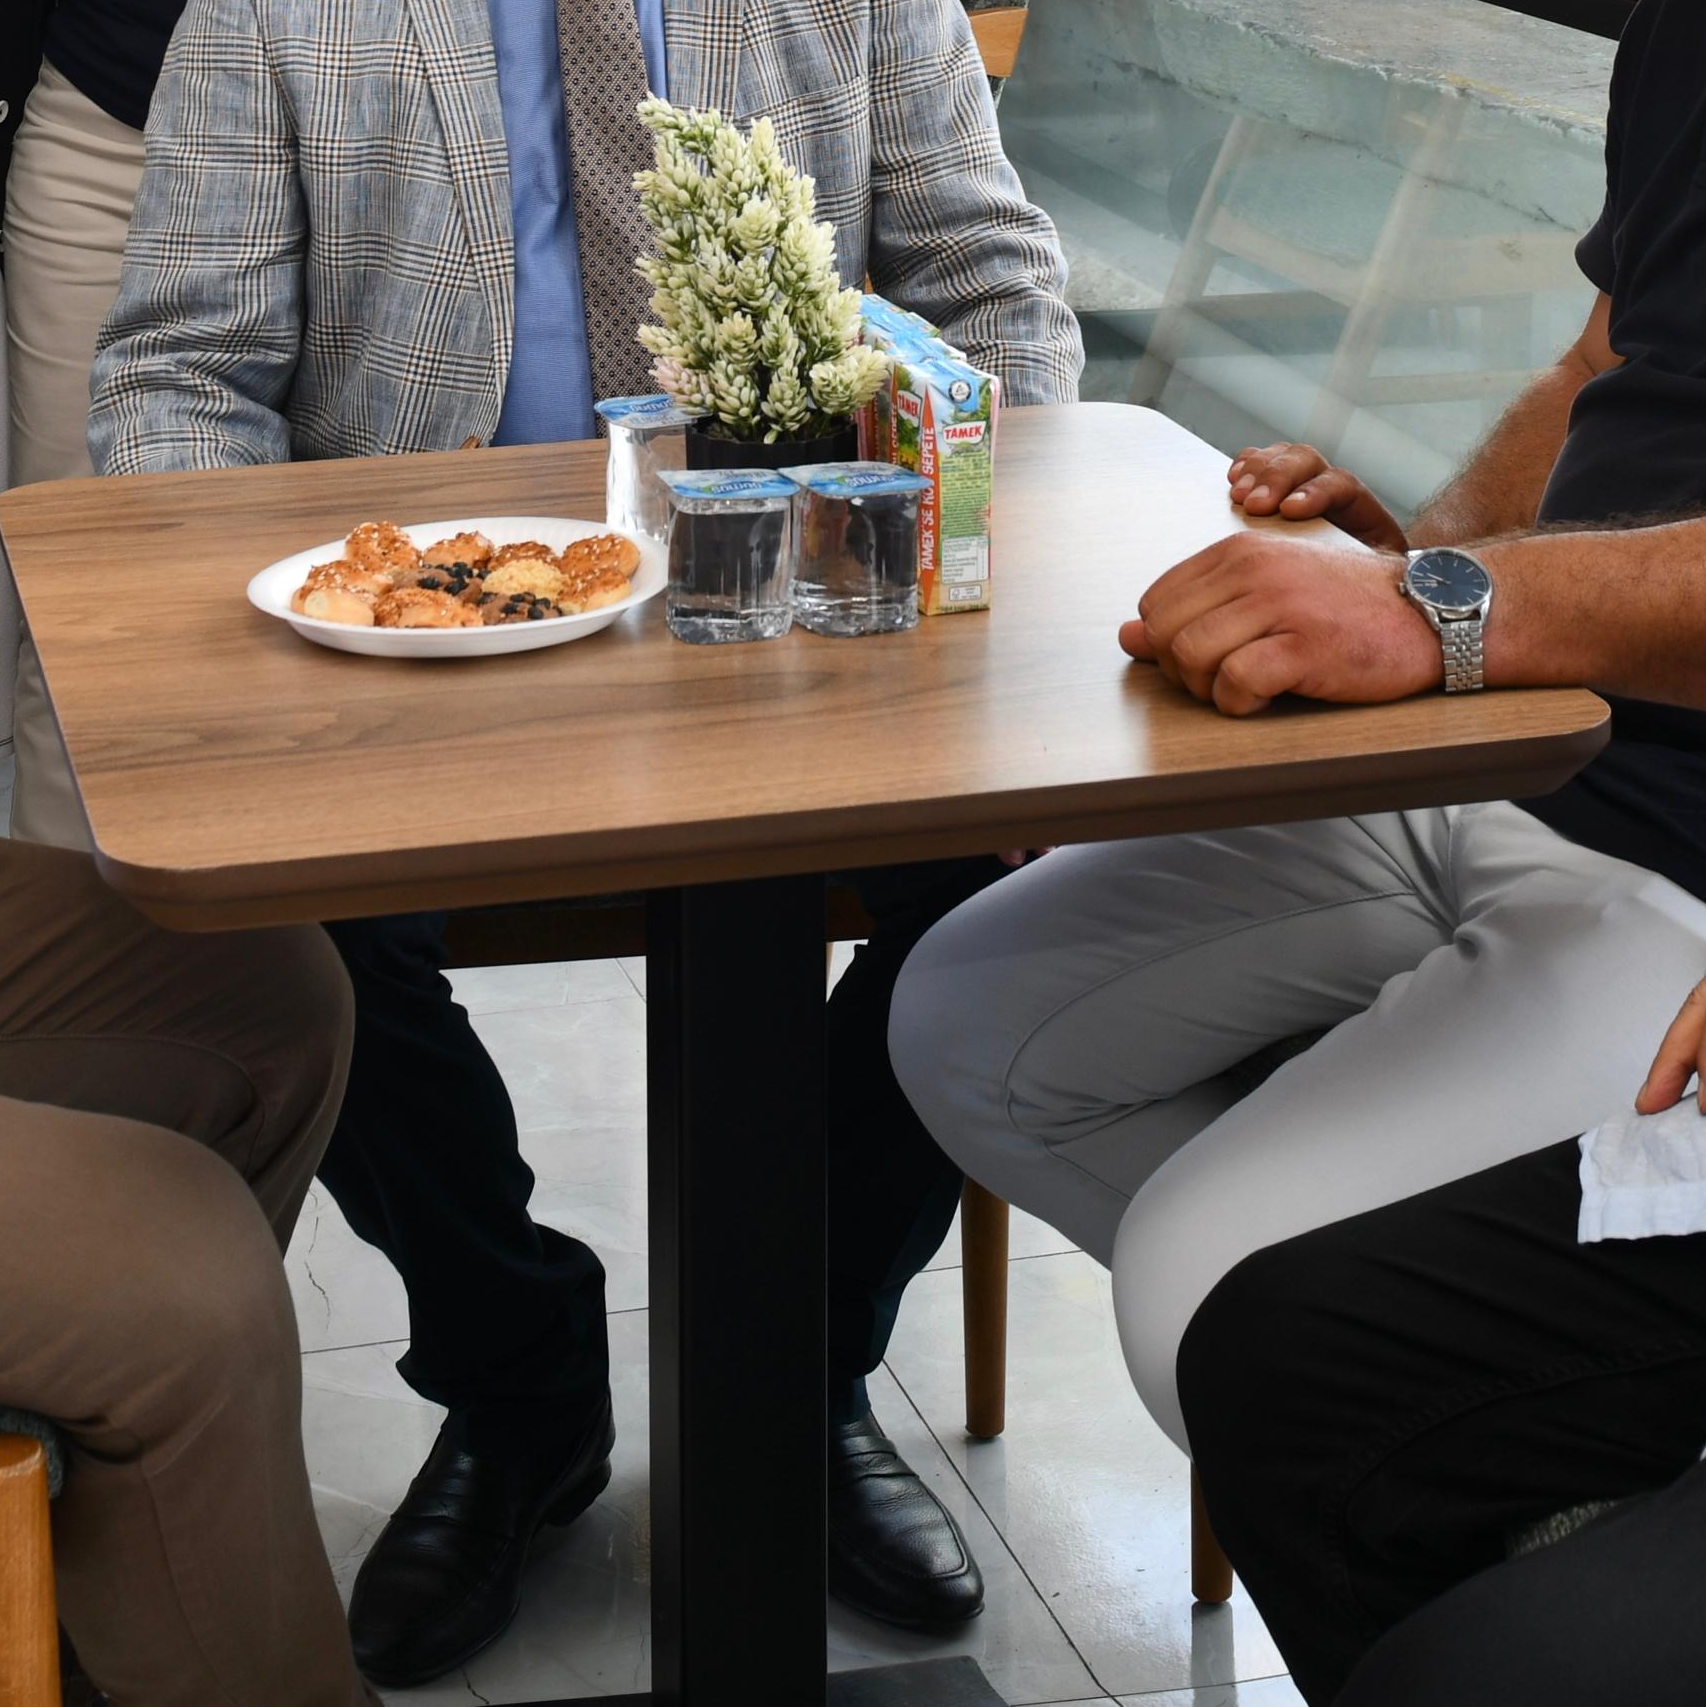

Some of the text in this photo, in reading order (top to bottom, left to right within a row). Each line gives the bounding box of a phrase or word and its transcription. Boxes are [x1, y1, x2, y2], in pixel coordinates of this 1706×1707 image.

[944, 425, 983, 440] TAMEK
[921, 426, 935, 475] SEPETE
[922, 477, 935, 505] KO
